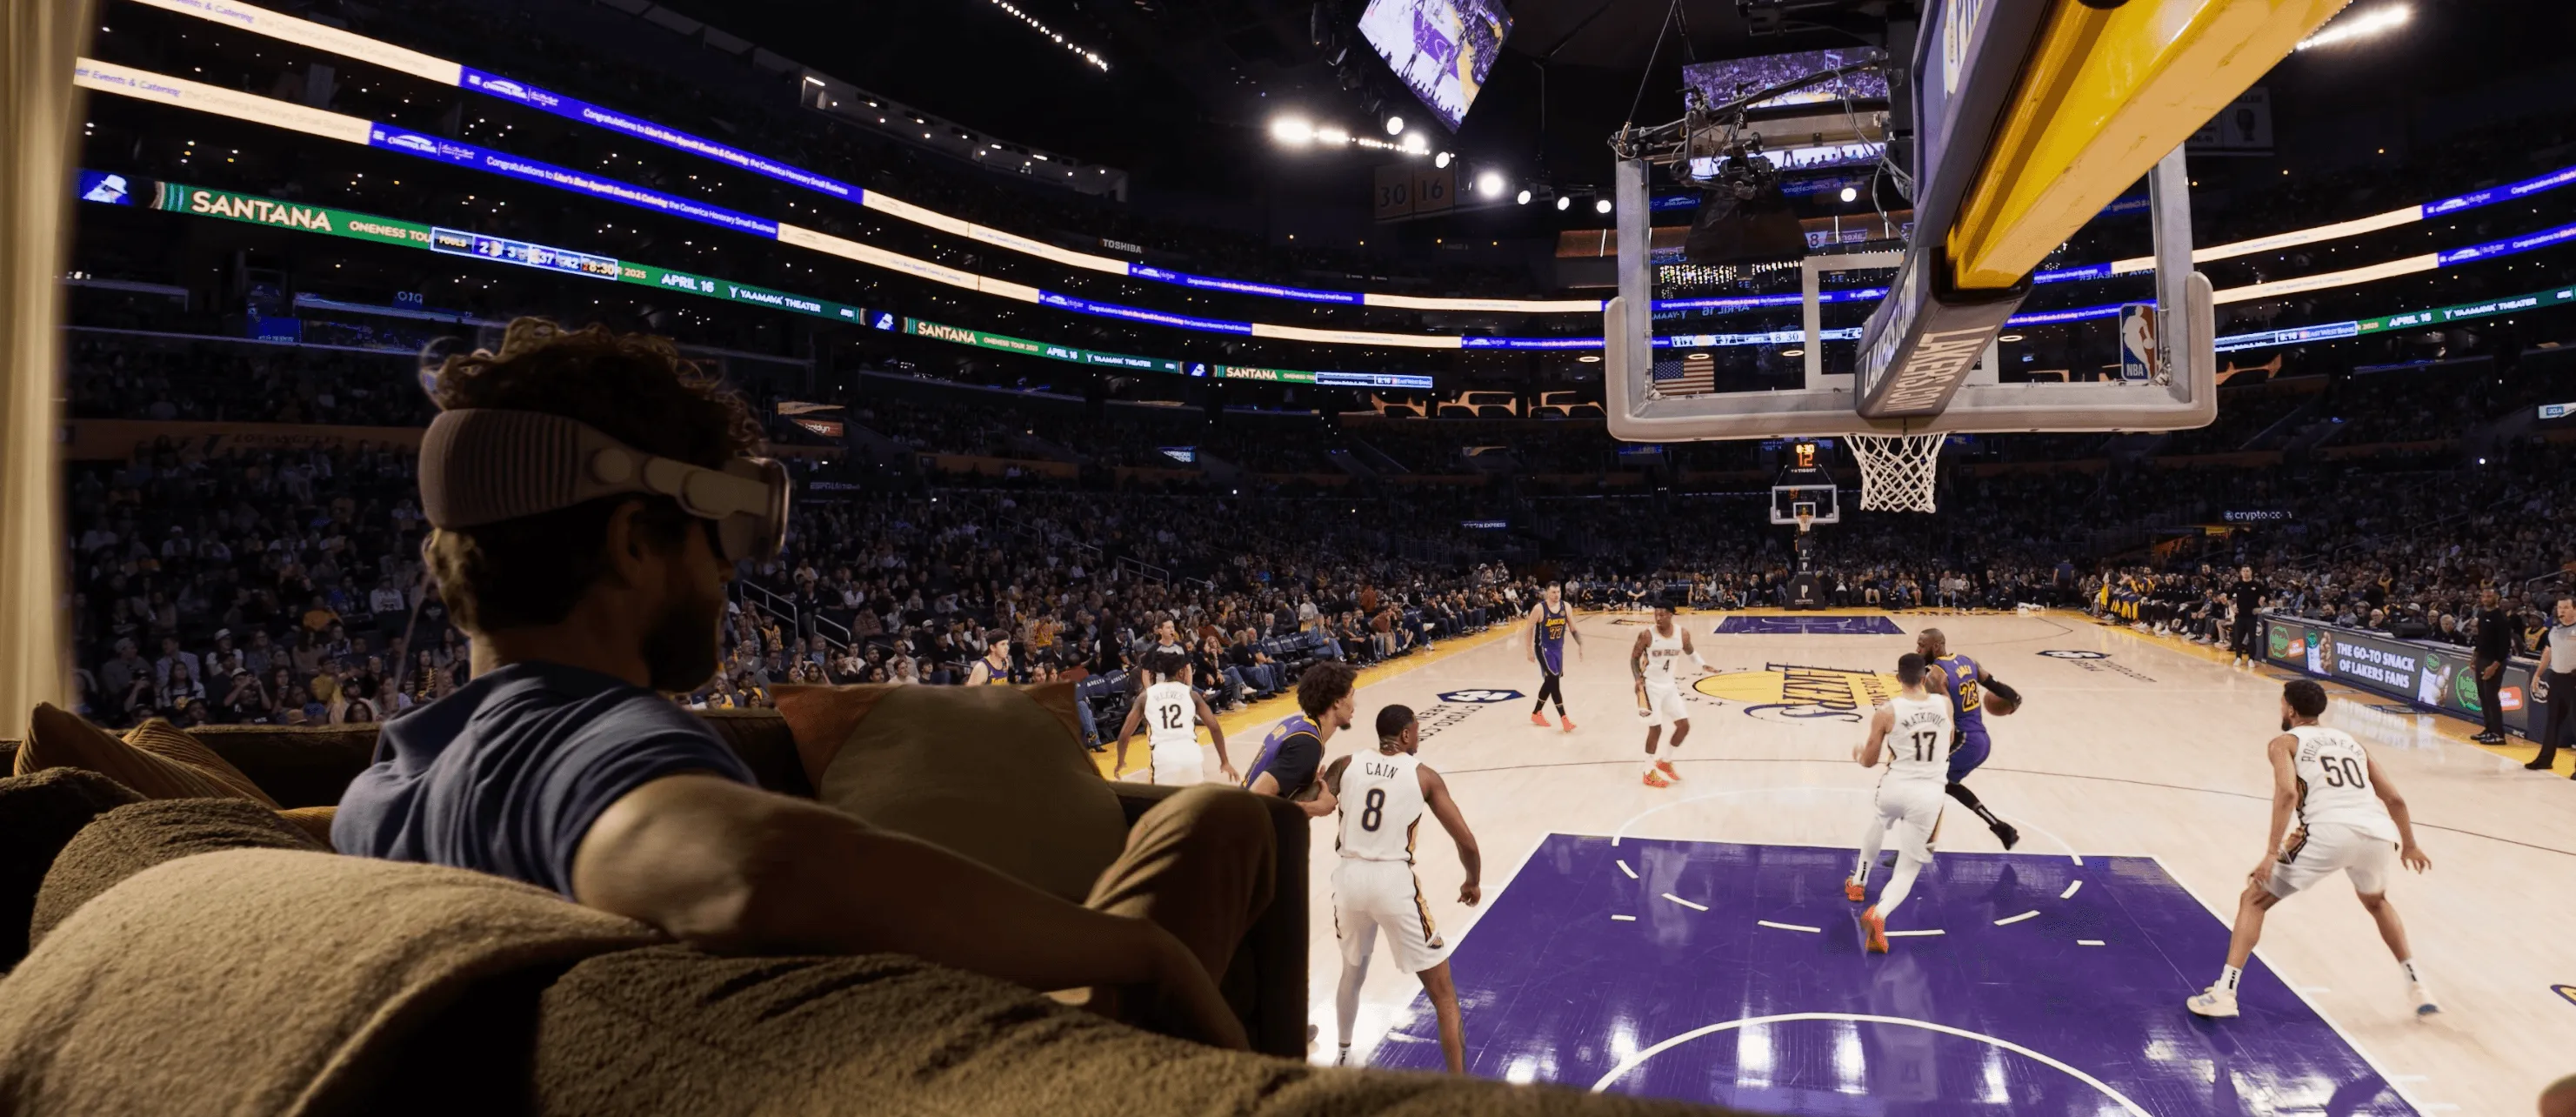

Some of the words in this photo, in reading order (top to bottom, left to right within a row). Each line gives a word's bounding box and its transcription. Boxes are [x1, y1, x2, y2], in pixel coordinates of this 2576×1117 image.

[584, 108, 637, 131] Congratulations
[487, 157, 545, 178] Congratulations
[642, 193, 669, 210] Catering
[680, 203, 709, 217] Comerica
[191, 191, 332, 231] SANTANA
[349, 220, 406, 239] ONENESS
[439, 235, 467, 248] FOULS
[479, 241, 489, 254] 2
[1102, 238, 1143, 253] TOSHIBA
[508, 246, 516, 258] 3
[539, 251, 556, 265] 37
[589, 261, 615, 277] 8:30
[624, 267, 647, 280] 2025
[661, 272, 697, 292] APRIL
[700, 279, 715, 294] 16
[784, 297, 821, 313] THEATER
[2499, 297, 2537, 311] THEATER
[2363, 321, 2379, 331] 2025
[2389, 314, 2419, 329] APRIL
[2421, 311, 2432, 323] 16
[918, 322, 977, 345] SANTANA
[1046, 346, 1069, 358] APRIL
[1069, 350, 1078, 360] 16
[1124, 357, 1151, 368] THEATER
[1884, 324, 1996, 412] LAKERS.COM
[2126, 364, 2144, 377] NBA
[1225, 366, 1278, 381] SANTANA
[1799, 453, 1812, 466] 12
[1550, 626, 1563, 640] 77
[2336, 642, 2352, 657] THE
[2353, 646, 2381, 666] GO-TO
[2382, 652, 2415, 672] SNACK
[1663, 659, 1670, 672] 4
[2339, 658, 2350, 673] OF
[2351, 662, 2384, 683] LAKERS
[2385, 670, 2410, 689] FANS
[1959, 679, 1980, 712] 23
[1159, 704, 1183, 730] 12
[1912, 732, 1937, 762] 17
[1366, 762, 1398, 779] CAIN
[2320, 756, 2366, 789] 50
[1362, 788, 1385, 832] 8
